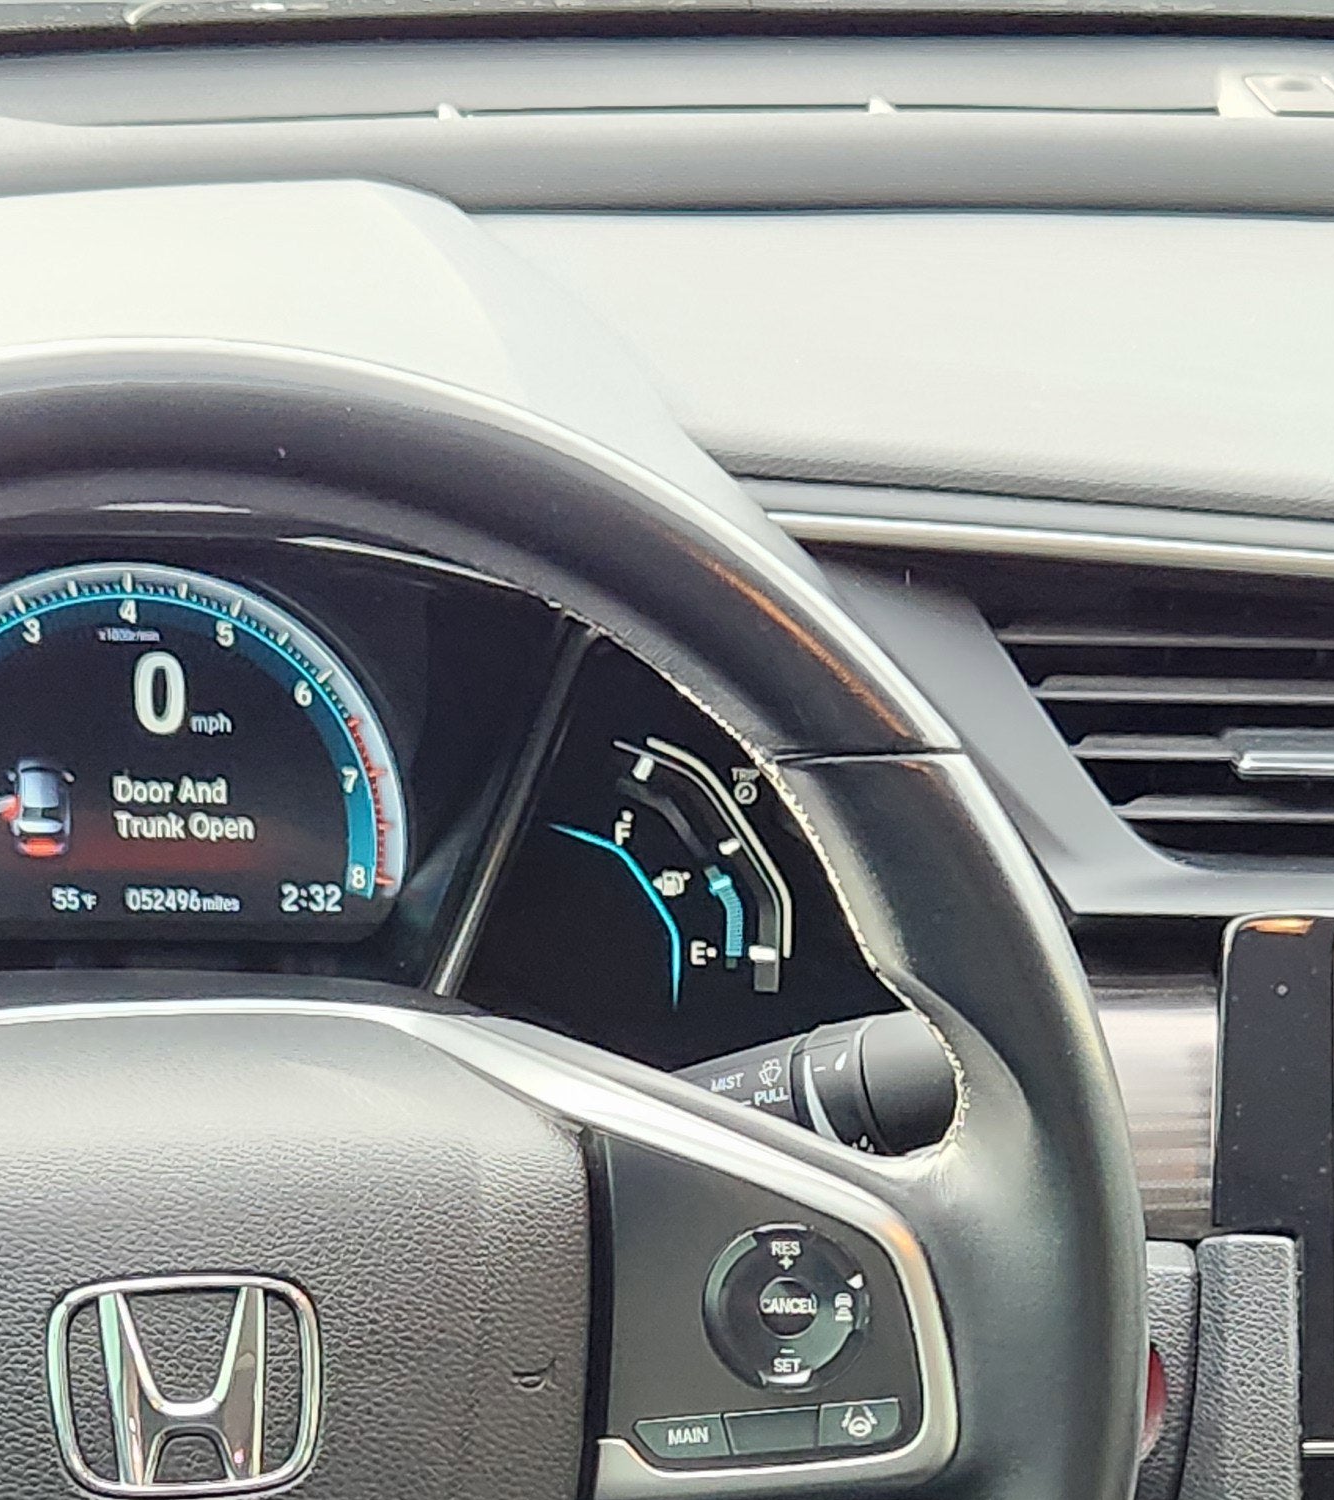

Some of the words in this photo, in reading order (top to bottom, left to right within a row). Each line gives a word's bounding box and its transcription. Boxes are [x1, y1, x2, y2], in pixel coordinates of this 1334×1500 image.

[119, 599, 138, 624] 4
[21, 617, 42, 643] 3
[216, 620, 235, 648] 5
[132, 650, 186, 736] 0
[190, 712, 233, 736] mph
[293, 680, 313, 706] 6
[111, 774, 174, 804] Door
[178, 775, 228, 804] And
[341, 766, 358, 792] 7
[115, 813, 185, 841] Trunk
[188, 813, 255, 844] Open
[615, 820, 632, 846] F
[350, 865, 366, 889] 8
[280, 883, 343, 912] 2:32
[690, 940, 707, 966] E
[710, 1072, 745, 1093] MIST
[754, 1086, 790, 1106] PULL
[771, 1241, 801, 1256] RES
[759, 1298, 818, 1315] CANCEL
[773, 1357, 801, 1374] SET
[667, 1426, 709, 1446] MAIN
